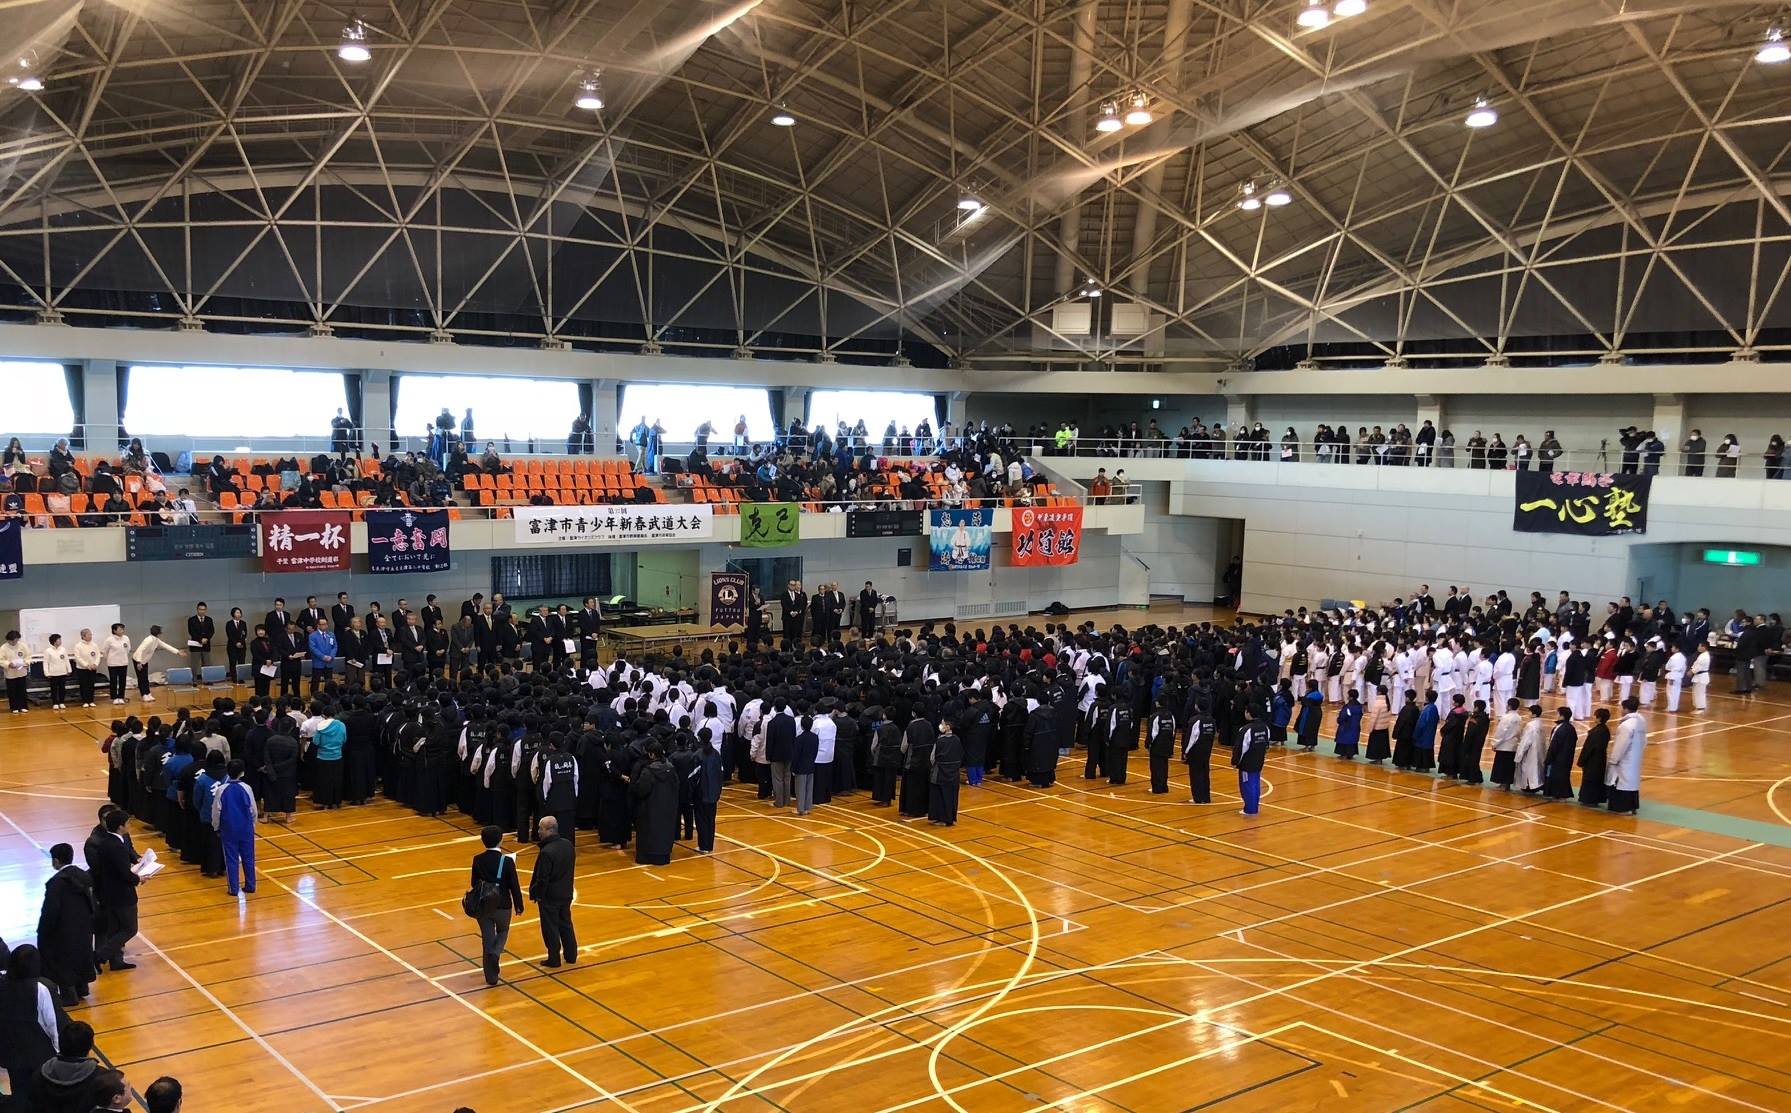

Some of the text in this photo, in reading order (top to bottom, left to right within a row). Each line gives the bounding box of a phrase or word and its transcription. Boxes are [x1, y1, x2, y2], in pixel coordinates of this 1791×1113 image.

[528, 515, 702, 535] 富津市青少年新春武道大会
[268, 523, 346, 552] 精一杯
[371, 527, 448, 552] 一意奮闘
[713, 577, 745, 586] LIONS CLUB
[724, 590, 732, 600] L
